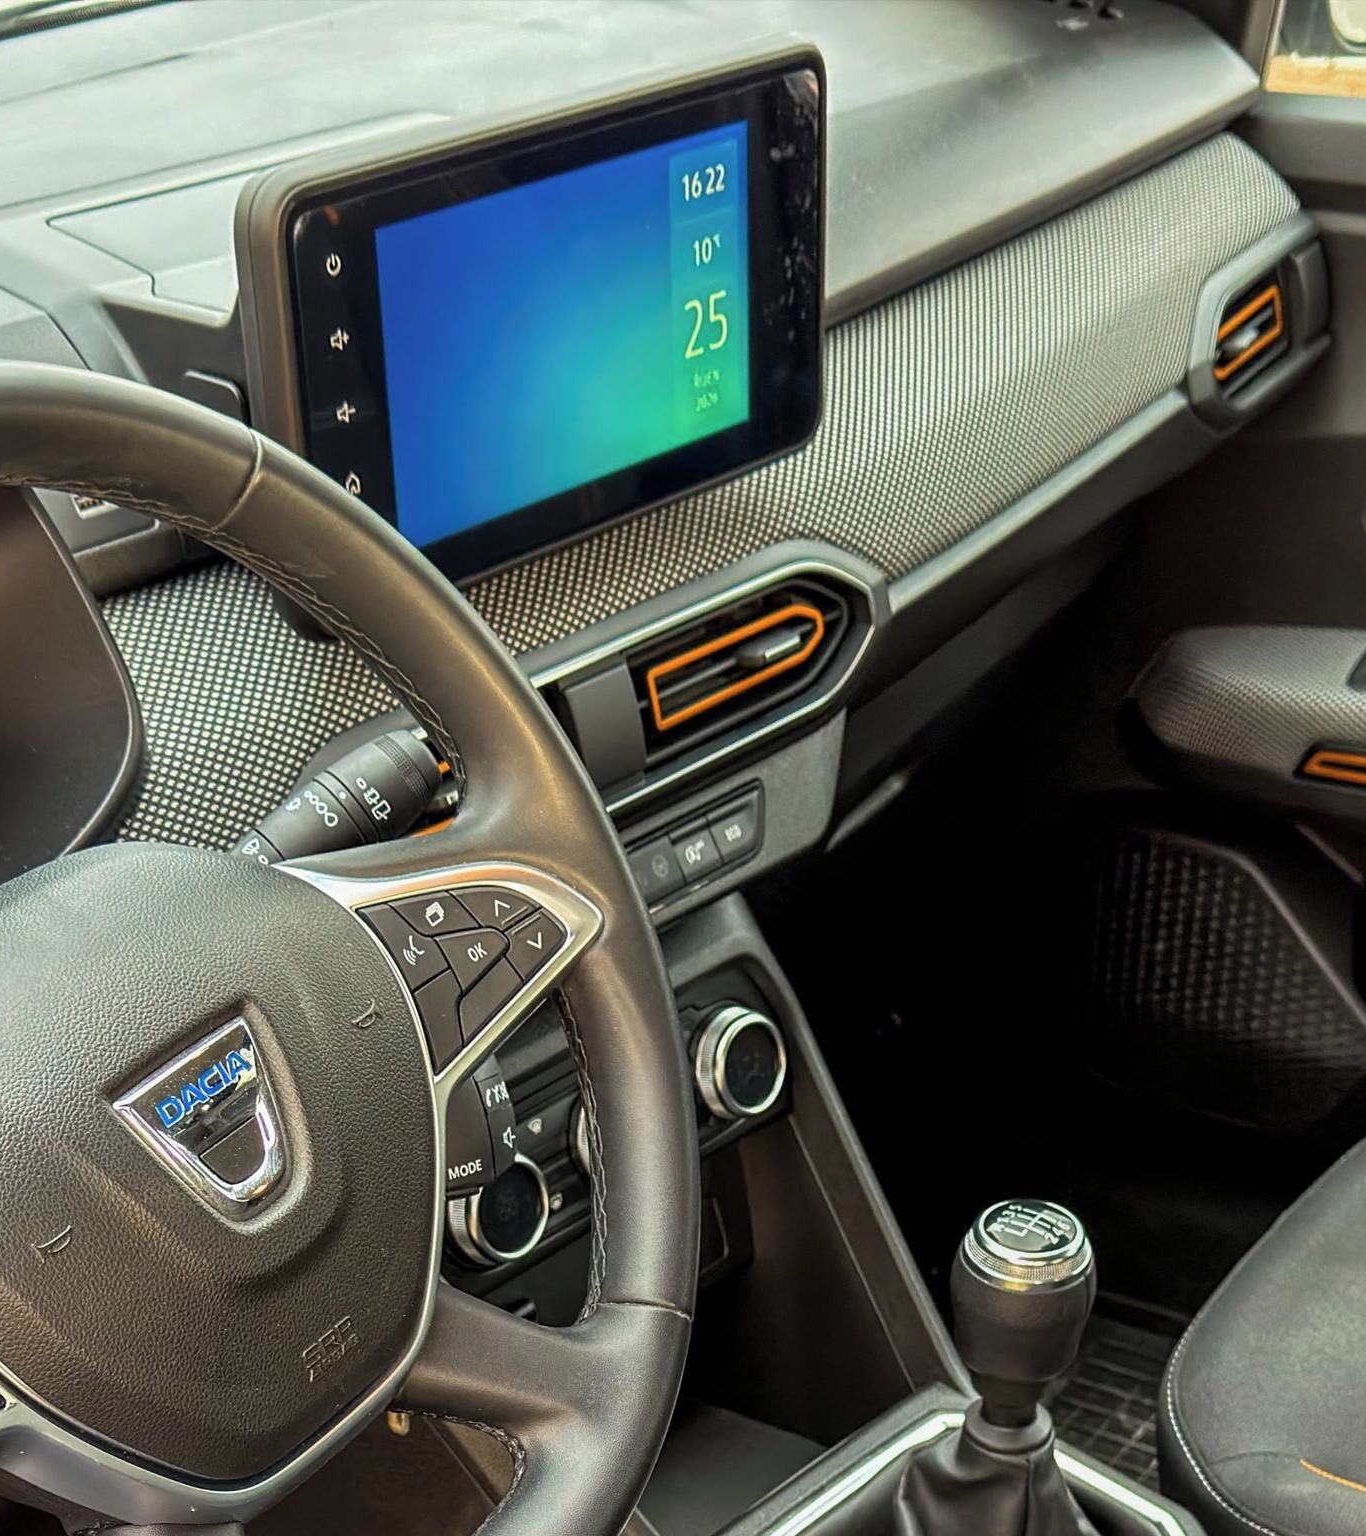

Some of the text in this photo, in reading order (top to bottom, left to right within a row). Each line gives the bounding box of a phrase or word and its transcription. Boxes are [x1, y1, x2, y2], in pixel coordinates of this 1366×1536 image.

[685, 290, 728, 359] 25
[467, 942, 488, 963] OK
[155, 1050, 252, 1128] DACIA
[448, 1158, 483, 1181] MODE
